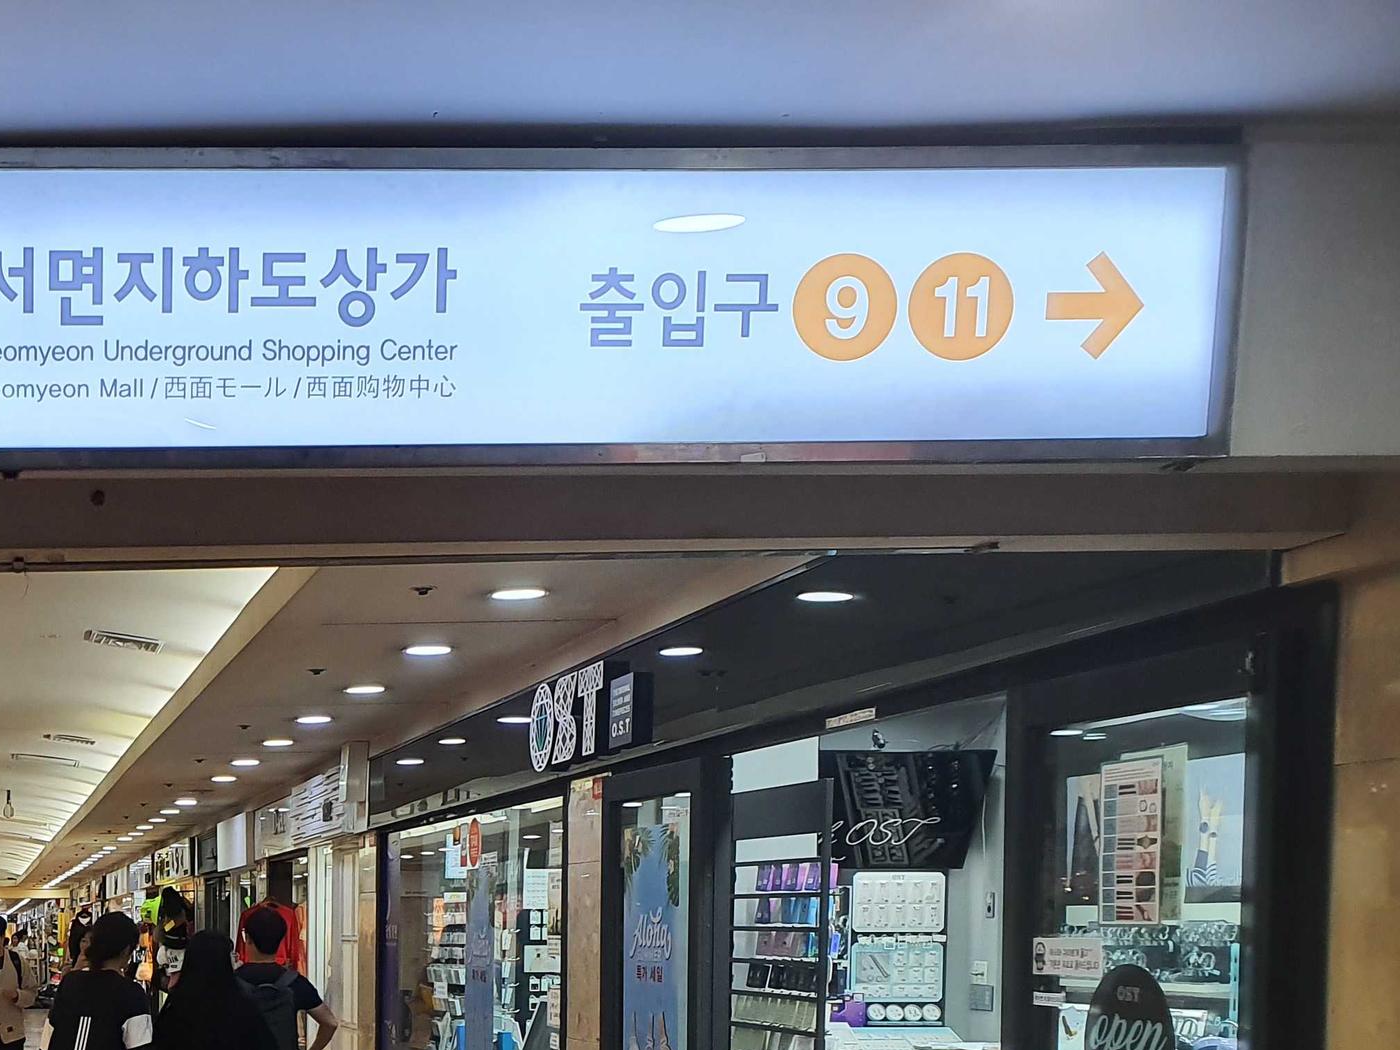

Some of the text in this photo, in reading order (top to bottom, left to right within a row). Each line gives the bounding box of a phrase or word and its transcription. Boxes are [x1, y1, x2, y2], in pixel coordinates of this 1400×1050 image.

[579, 266, 990, 348] 출입구 9 11
[103, 338, 253, 367] Underground
[261, 338, 371, 368] Shopping
[379, 338, 459, 362] Center
[99, 377, 144, 399] Mall
[164, 375, 287, 400] 西面モール
[305, 373, 457, 400] 西面购物中心
[530, 660, 604, 772] OST
[611, 717, 632, 739] O.S.T
[845, 816, 942, 846] OST
